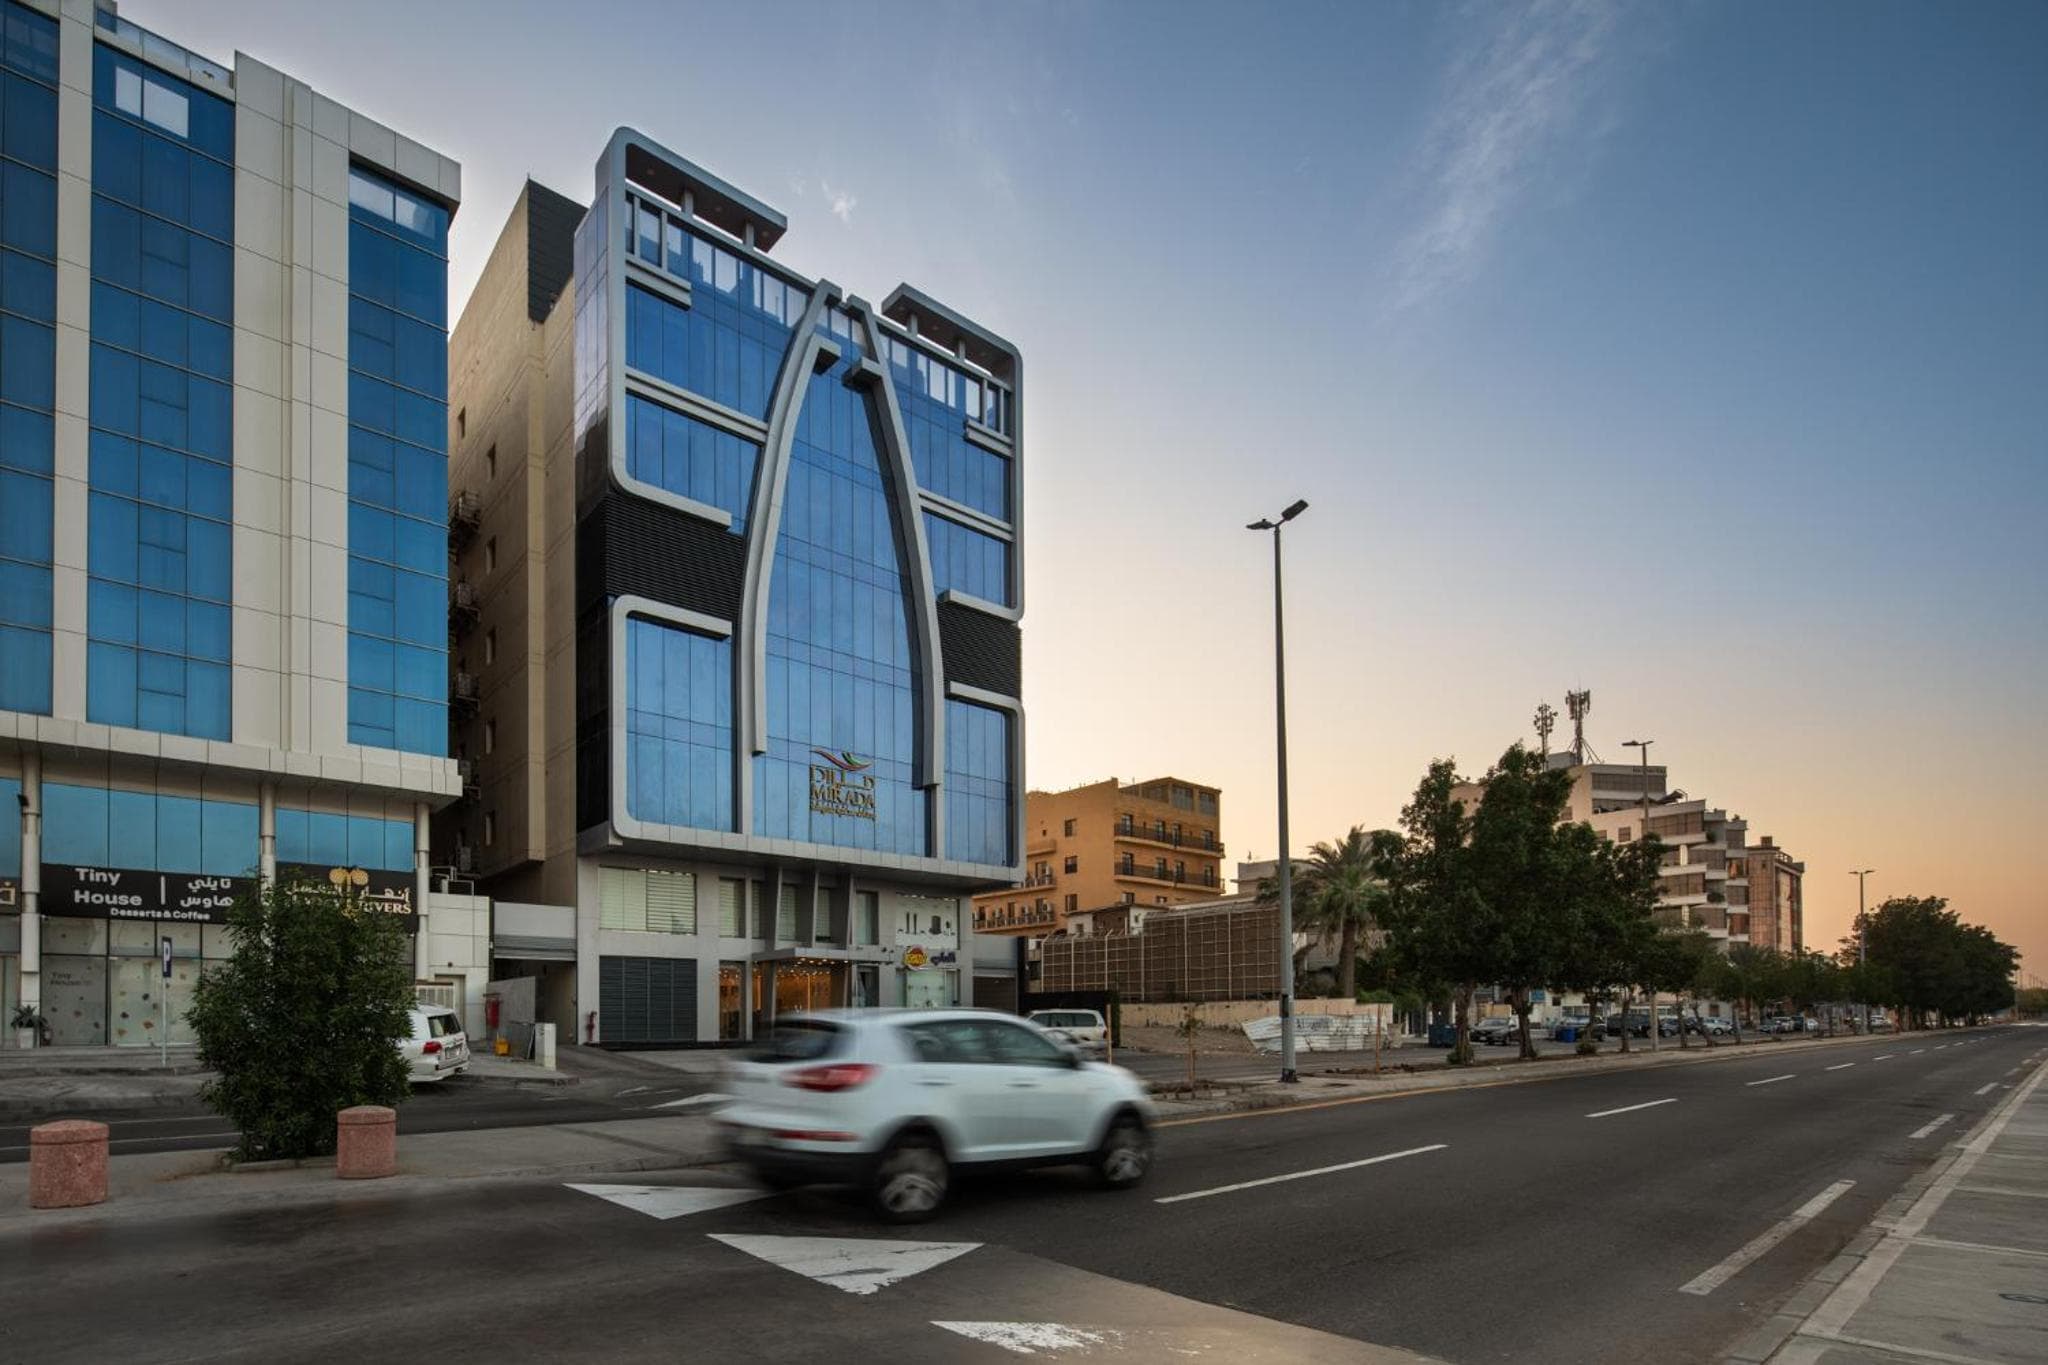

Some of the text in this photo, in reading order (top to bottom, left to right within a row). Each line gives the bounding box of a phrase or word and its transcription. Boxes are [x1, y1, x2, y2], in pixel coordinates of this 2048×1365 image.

[75, 868, 121, 886] Tiny
[73, 890, 143, 906] House
[180, 895, 234, 908] هاوس
[110, 907, 163, 918] Desserts
[173, 910, 210, 920] Coffee
[163, 941, 171, 973] P
